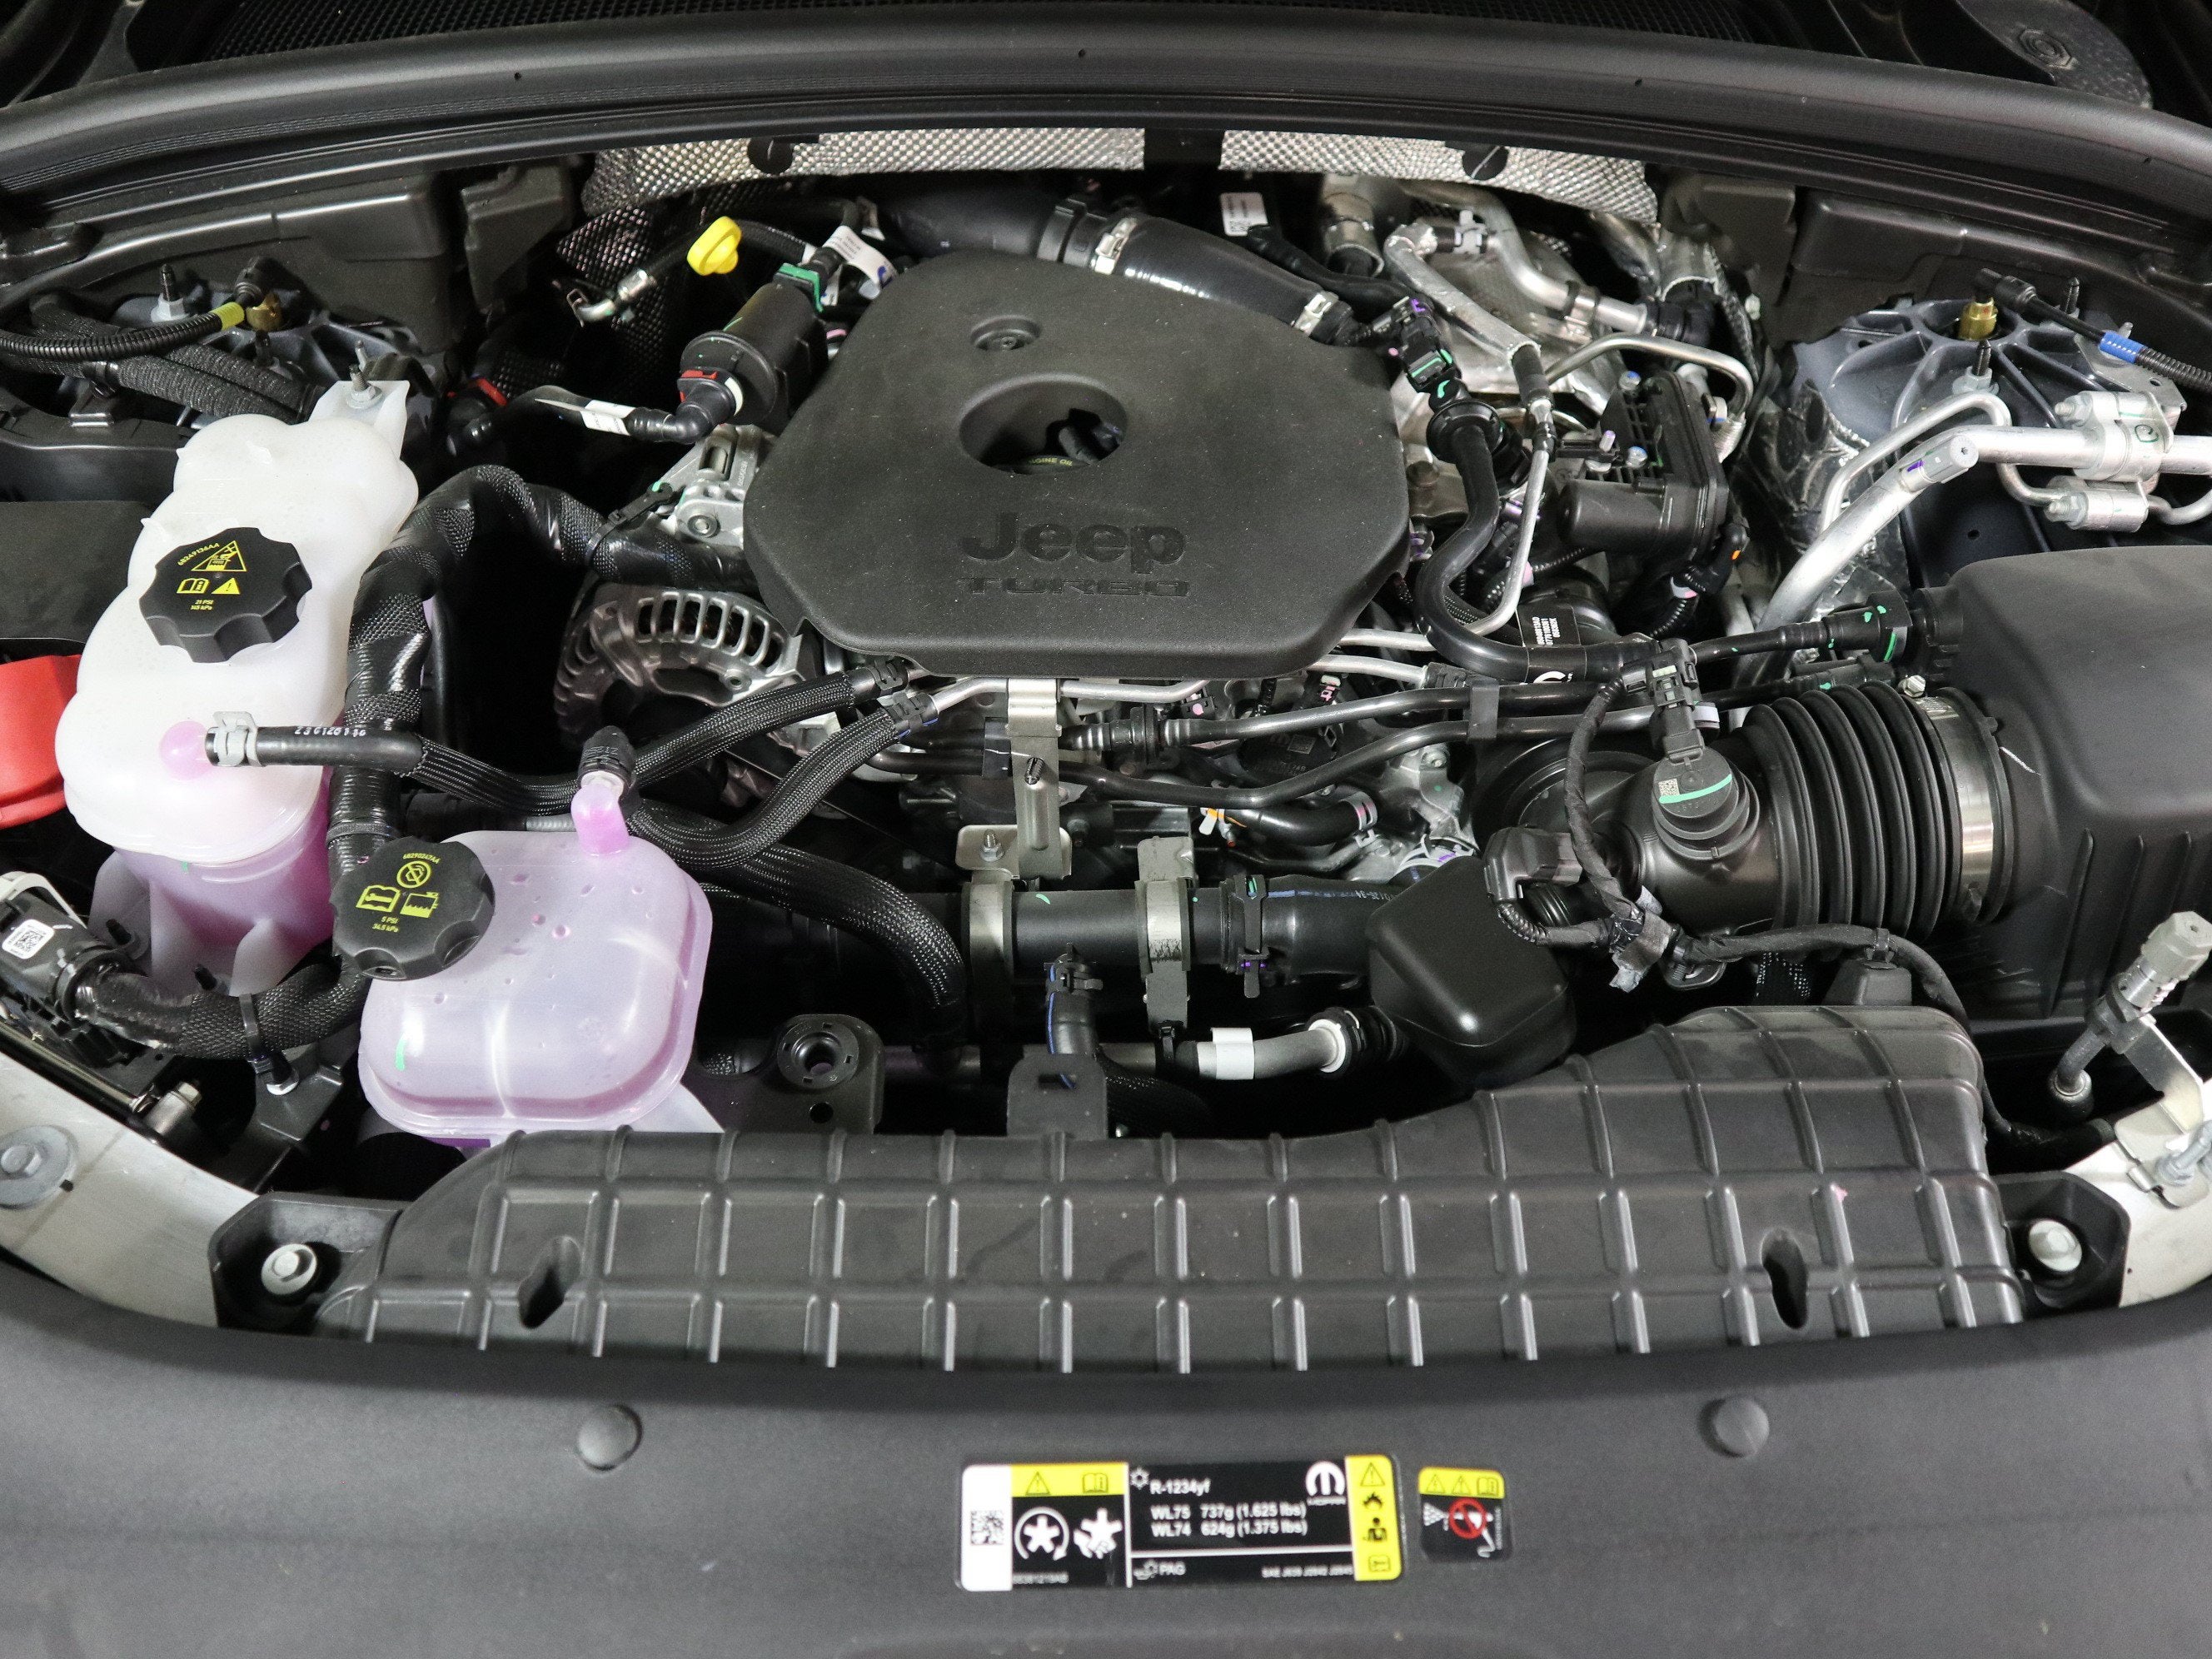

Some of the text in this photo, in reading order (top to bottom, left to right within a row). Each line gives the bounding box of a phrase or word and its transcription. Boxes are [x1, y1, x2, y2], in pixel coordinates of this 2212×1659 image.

[962, 512, 1186, 574] Jeep
[958, 578, 1190, 596] TURBO
[386, 924, 399, 933] kPa
[1150, 1478, 1211, 1497] R-1234yf
[1150, 1501, 1307, 1522] WL75 737g (1.625 lbs)
[1151, 1518, 1308, 1539] WL74 624g (1.375 lbs)
[1158, 1562, 1186, 1576] PAG
